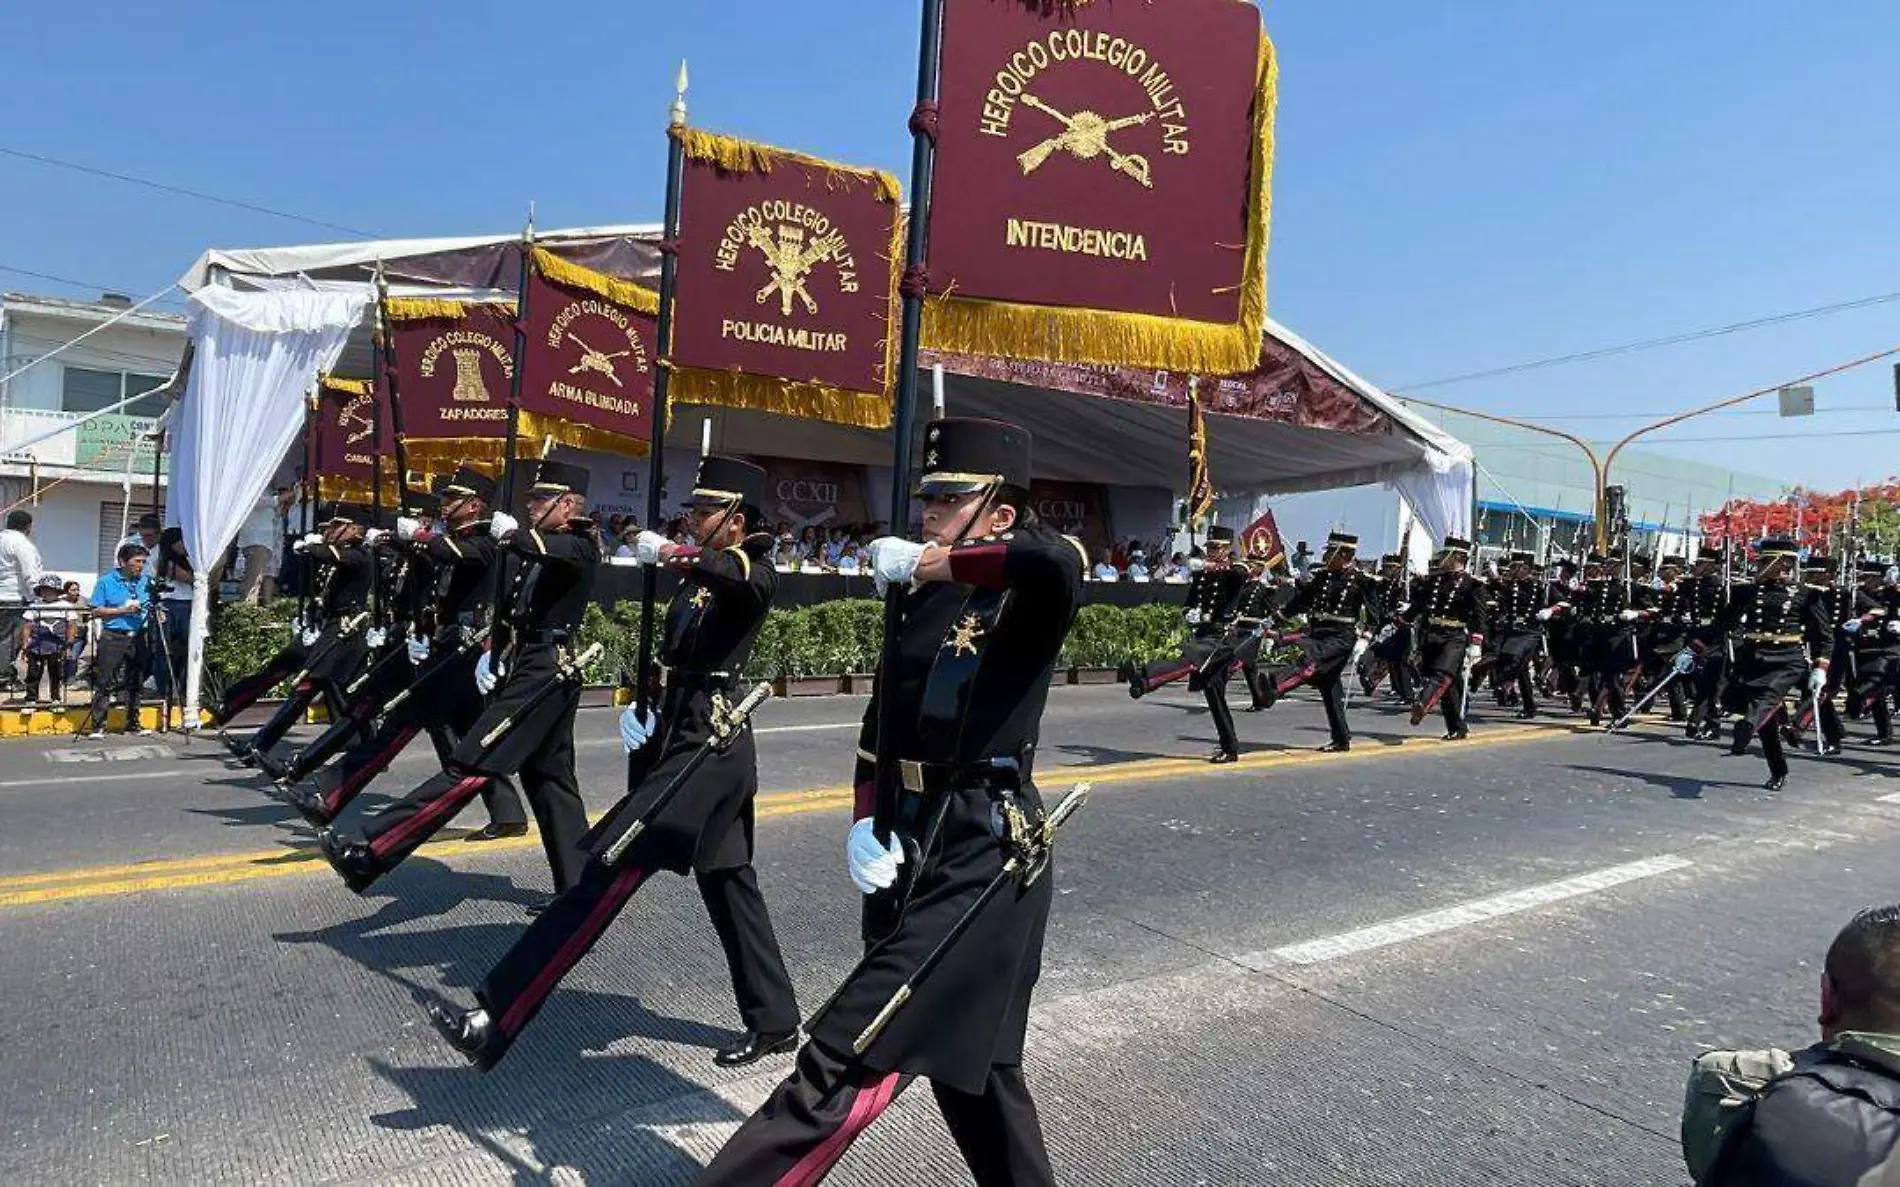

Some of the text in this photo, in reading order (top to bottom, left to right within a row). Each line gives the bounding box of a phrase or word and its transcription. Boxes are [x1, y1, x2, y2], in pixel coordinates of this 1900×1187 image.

[980, 29, 1189, 155] HEROICO COLEGIO MILITAR
[715, 200, 859, 293] HEROICO COLEGIO MILITAR
[1006, 218, 1147, 261] INTENDENCIA
[420, 337, 448, 377] HEROICO
[446, 330, 492, 347] COLEGIO
[548, 300, 648, 374] HEROICO COLEGIO MILITAR
[722, 319, 847, 351] POLICIA MILITAR
[439, 407, 509, 420] ZAPADORES
[549, 381, 639, 416] ARMA BLINDADA
[777, 479, 839, 504] CCXII
